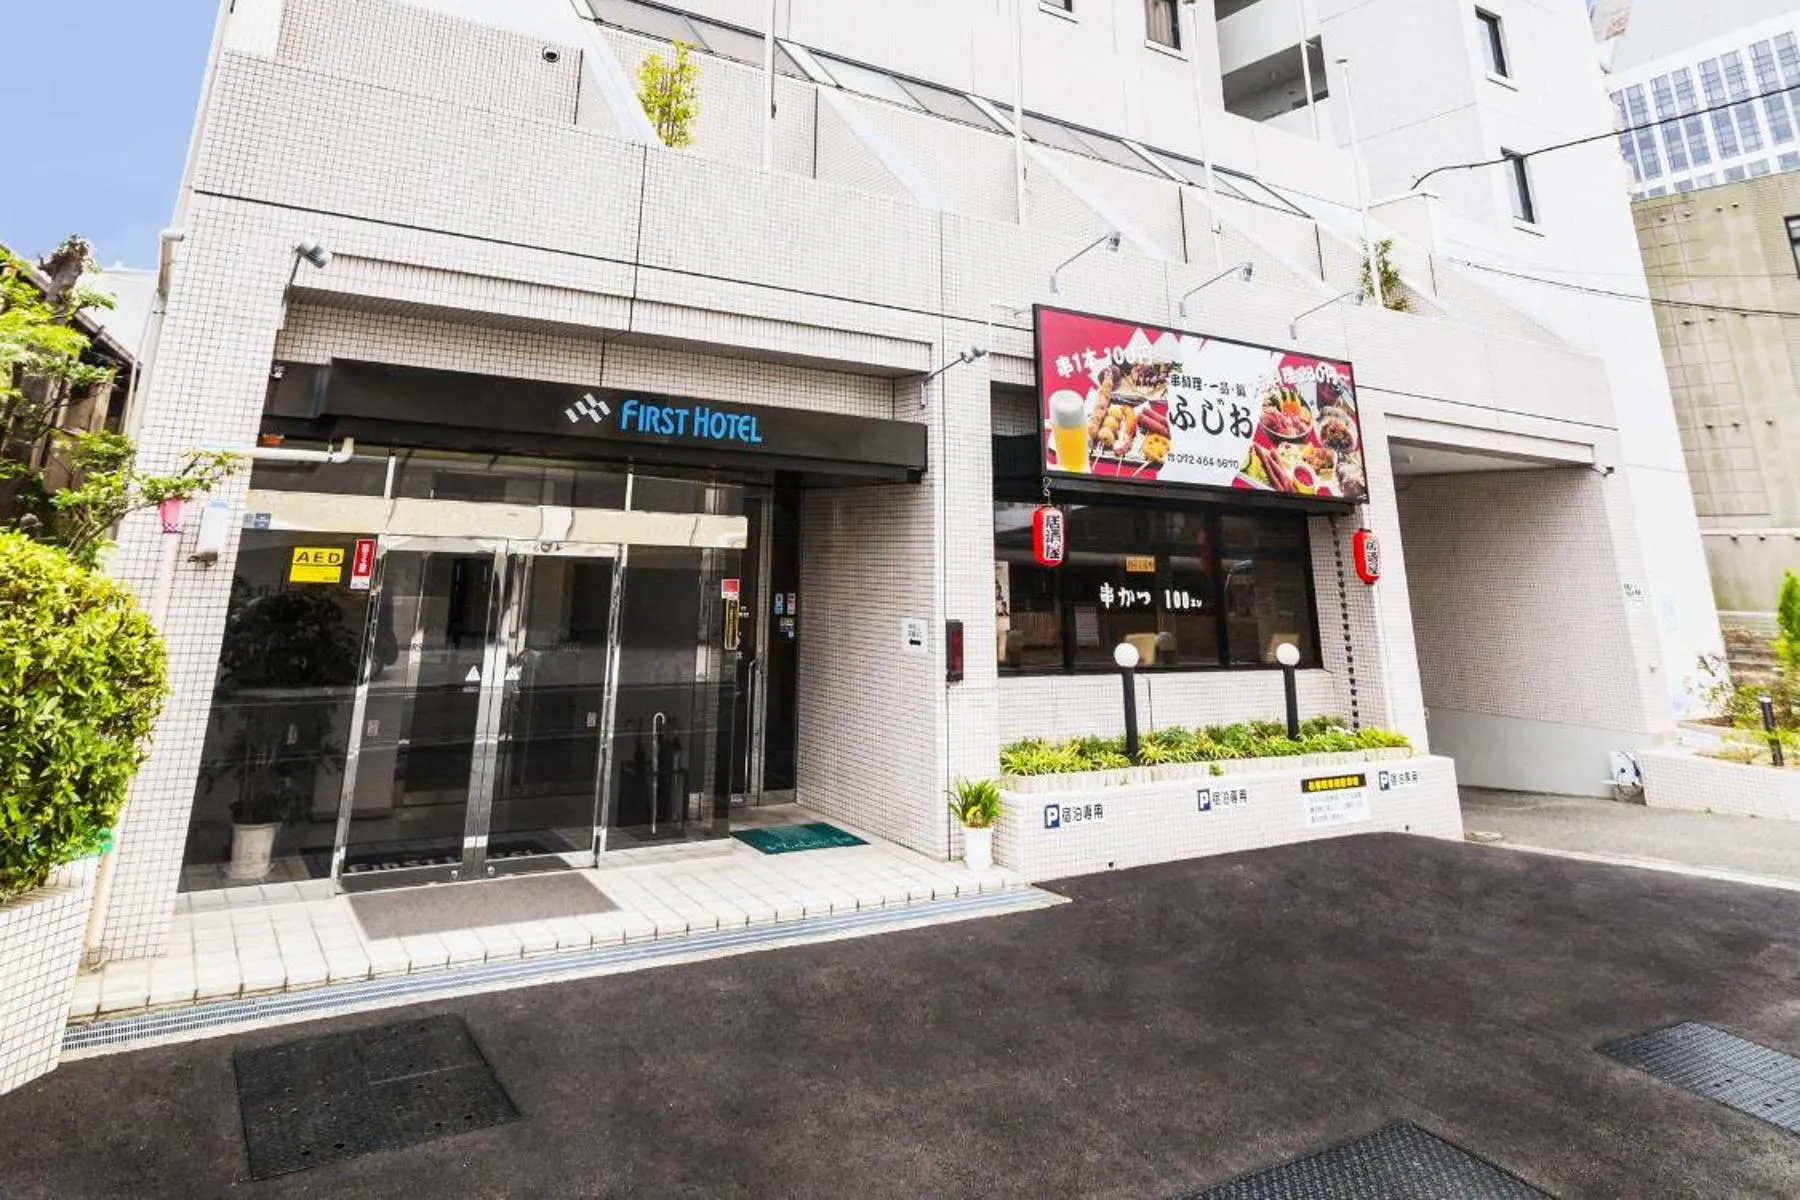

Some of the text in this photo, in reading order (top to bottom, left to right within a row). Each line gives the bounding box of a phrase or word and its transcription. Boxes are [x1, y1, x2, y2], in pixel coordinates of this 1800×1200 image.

[620, 399, 763, 443] FIRST HOTEL
[1169, 394, 1253, 439] ふじお
[296, 551, 340, 564] AED
[1099, 582, 1152, 609] 串かつ
